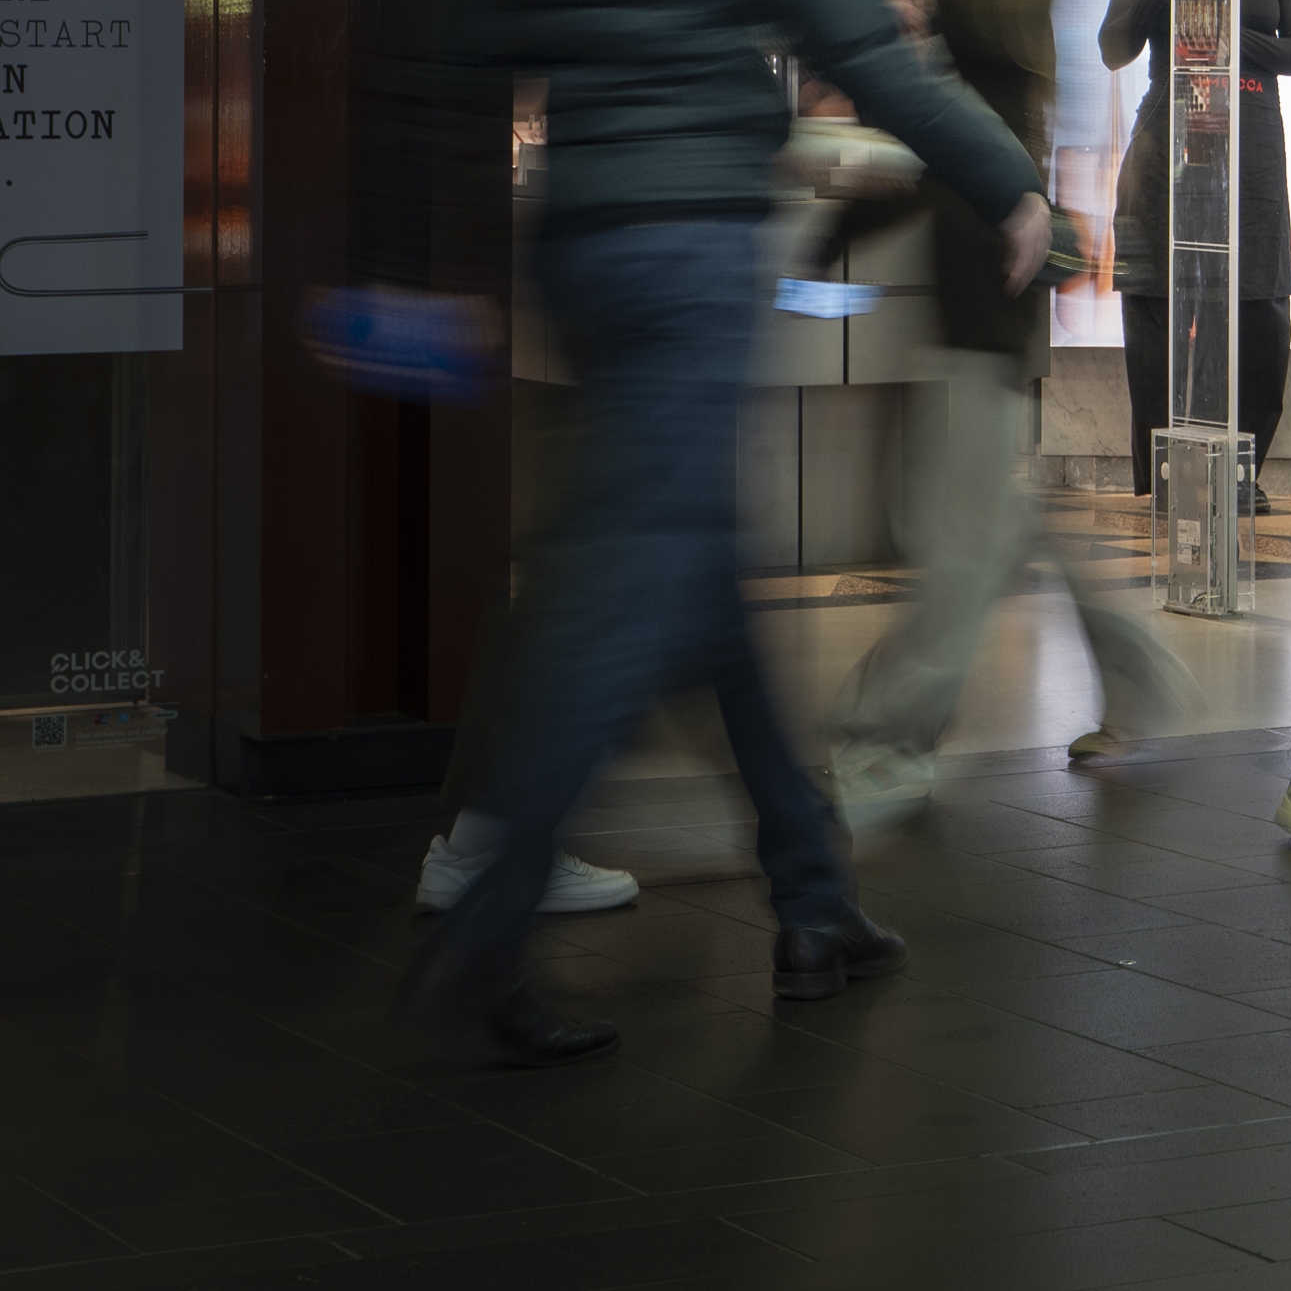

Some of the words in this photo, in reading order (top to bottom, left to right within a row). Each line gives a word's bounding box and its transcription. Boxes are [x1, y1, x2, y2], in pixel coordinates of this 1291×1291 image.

[0, 19, 131, 48] START
[50, 670, 165, 694] COLLECT
[92, 730, 126, 739] cameras
